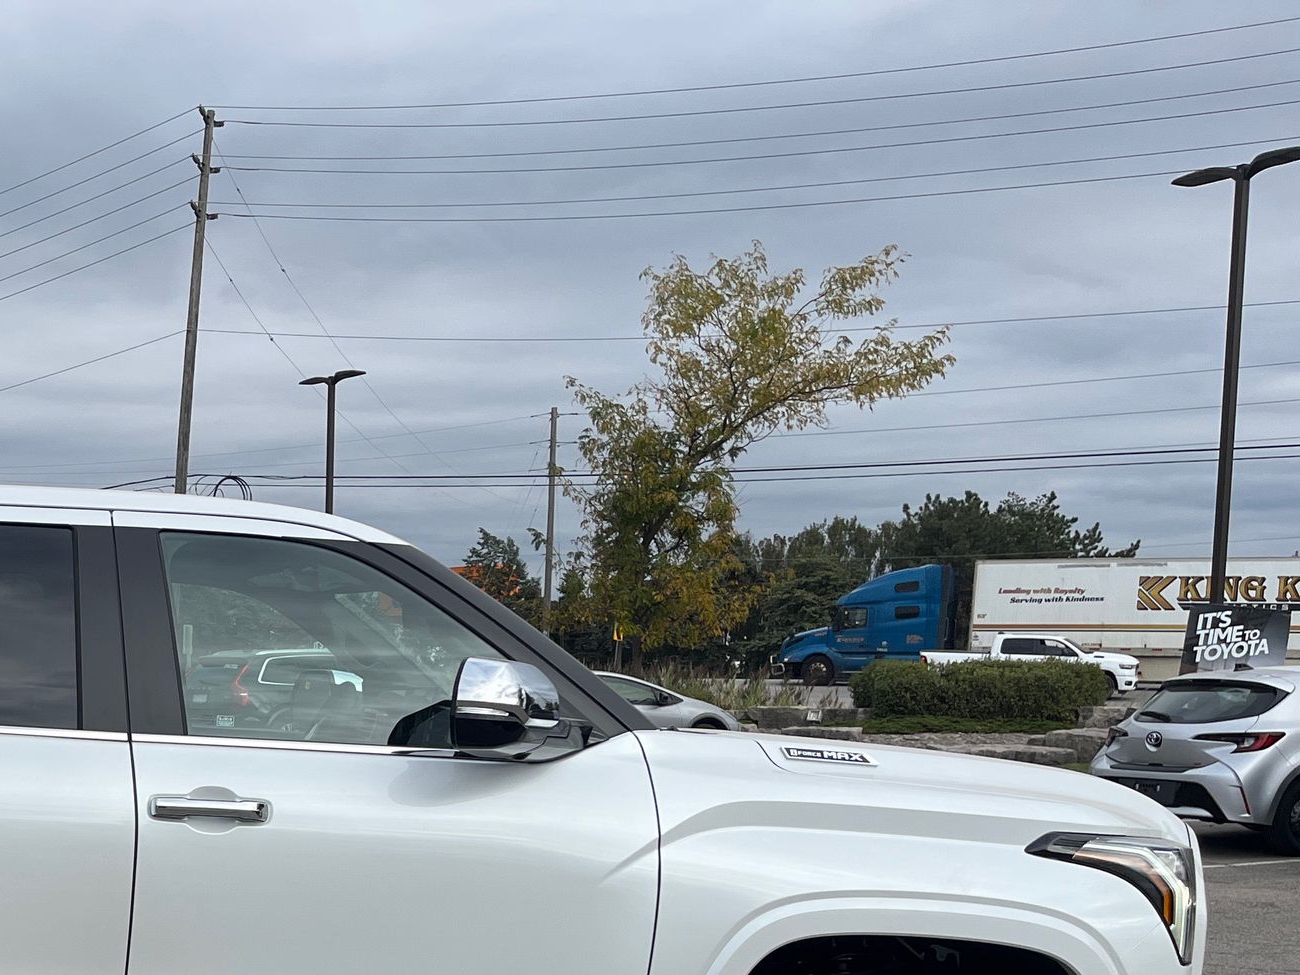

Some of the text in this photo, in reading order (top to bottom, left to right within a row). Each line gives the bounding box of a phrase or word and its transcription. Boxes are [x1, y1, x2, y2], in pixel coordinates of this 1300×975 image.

[998, 587, 1086, 595] Leading with Royalty
[1177, 575, 1267, 602] KING
[1009, 595, 1105, 604] Serving with Kindness
[1196, 610, 1233, 631] IT'S
[1195, 624, 1261, 646] TIME TO
[1193, 638, 1270, 663] TOYOTA
[823, 751, 863, 761] MAX
